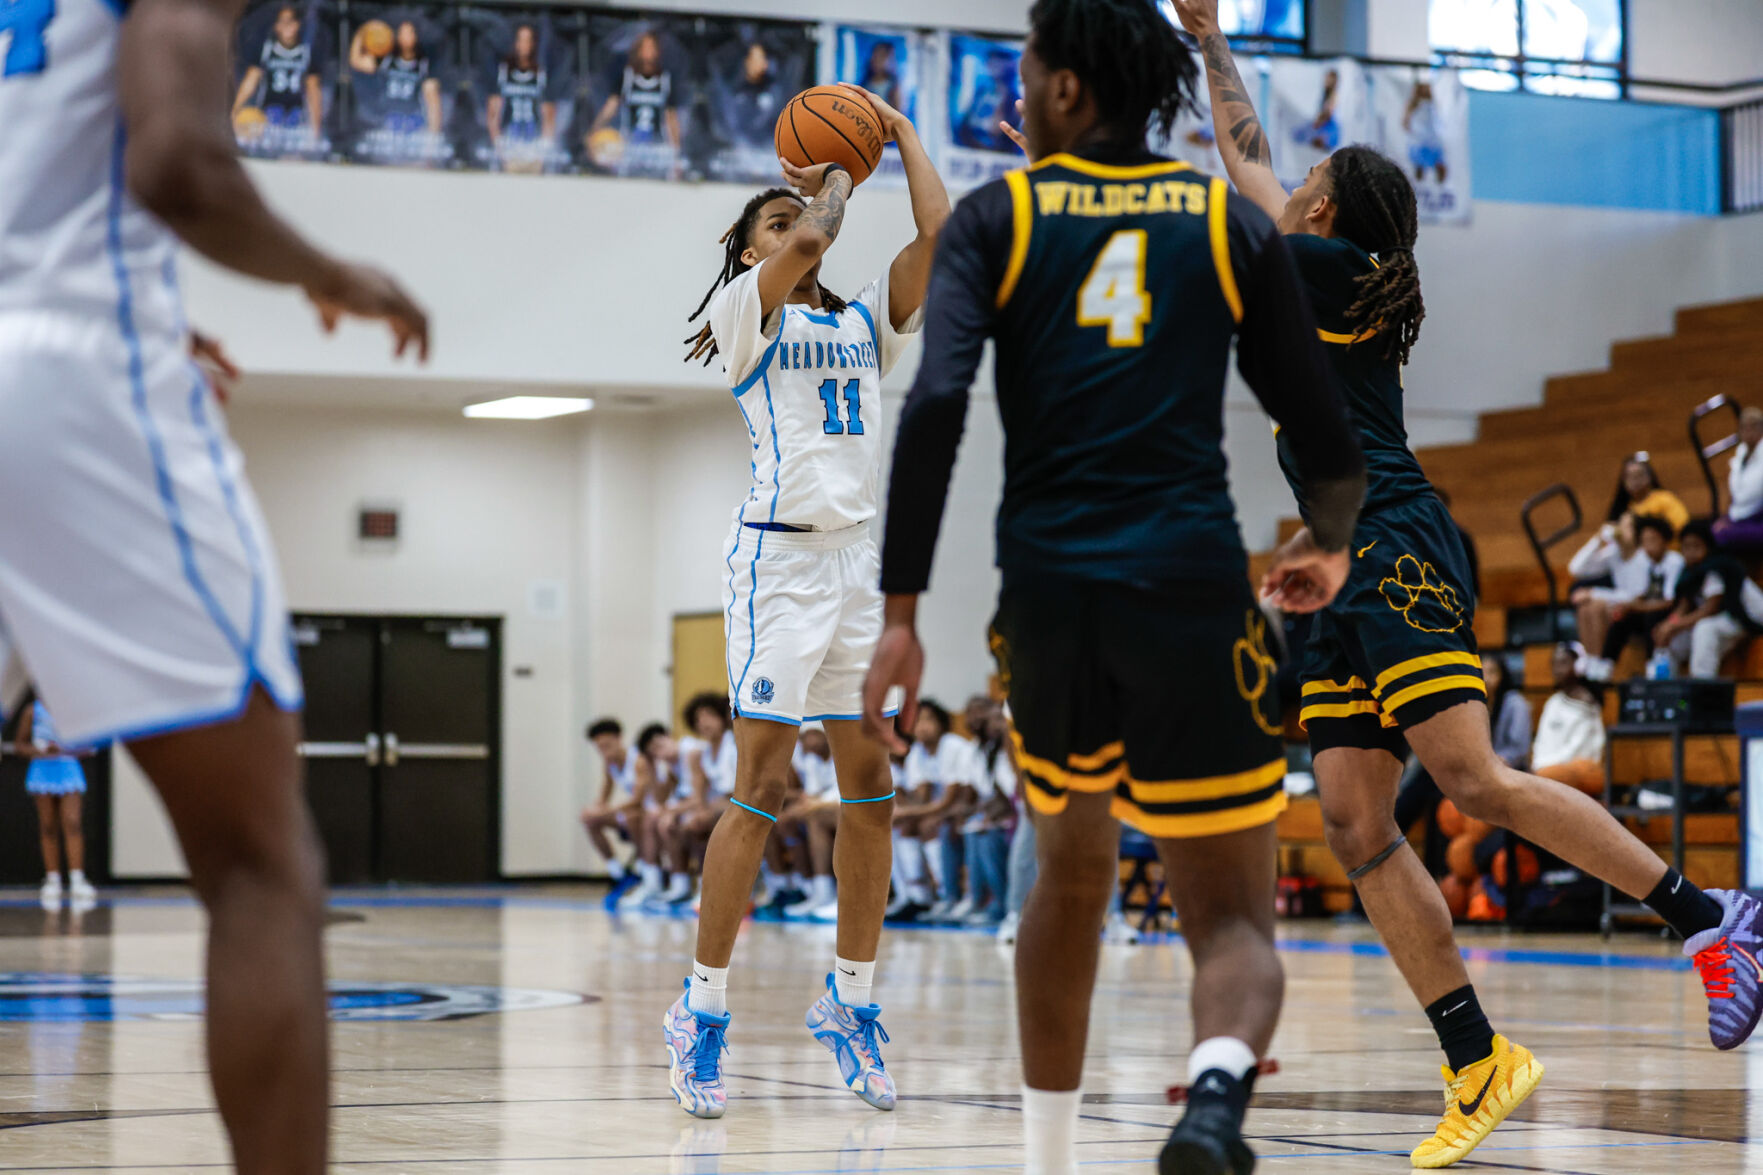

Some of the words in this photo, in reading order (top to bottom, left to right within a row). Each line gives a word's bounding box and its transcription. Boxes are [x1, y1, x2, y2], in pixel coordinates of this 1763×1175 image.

[831, 100, 881, 161] Wilson
[1035, 181, 1207, 216] WILDCATS
[1076, 229, 1151, 347] 4
[818, 379, 864, 435] 11
